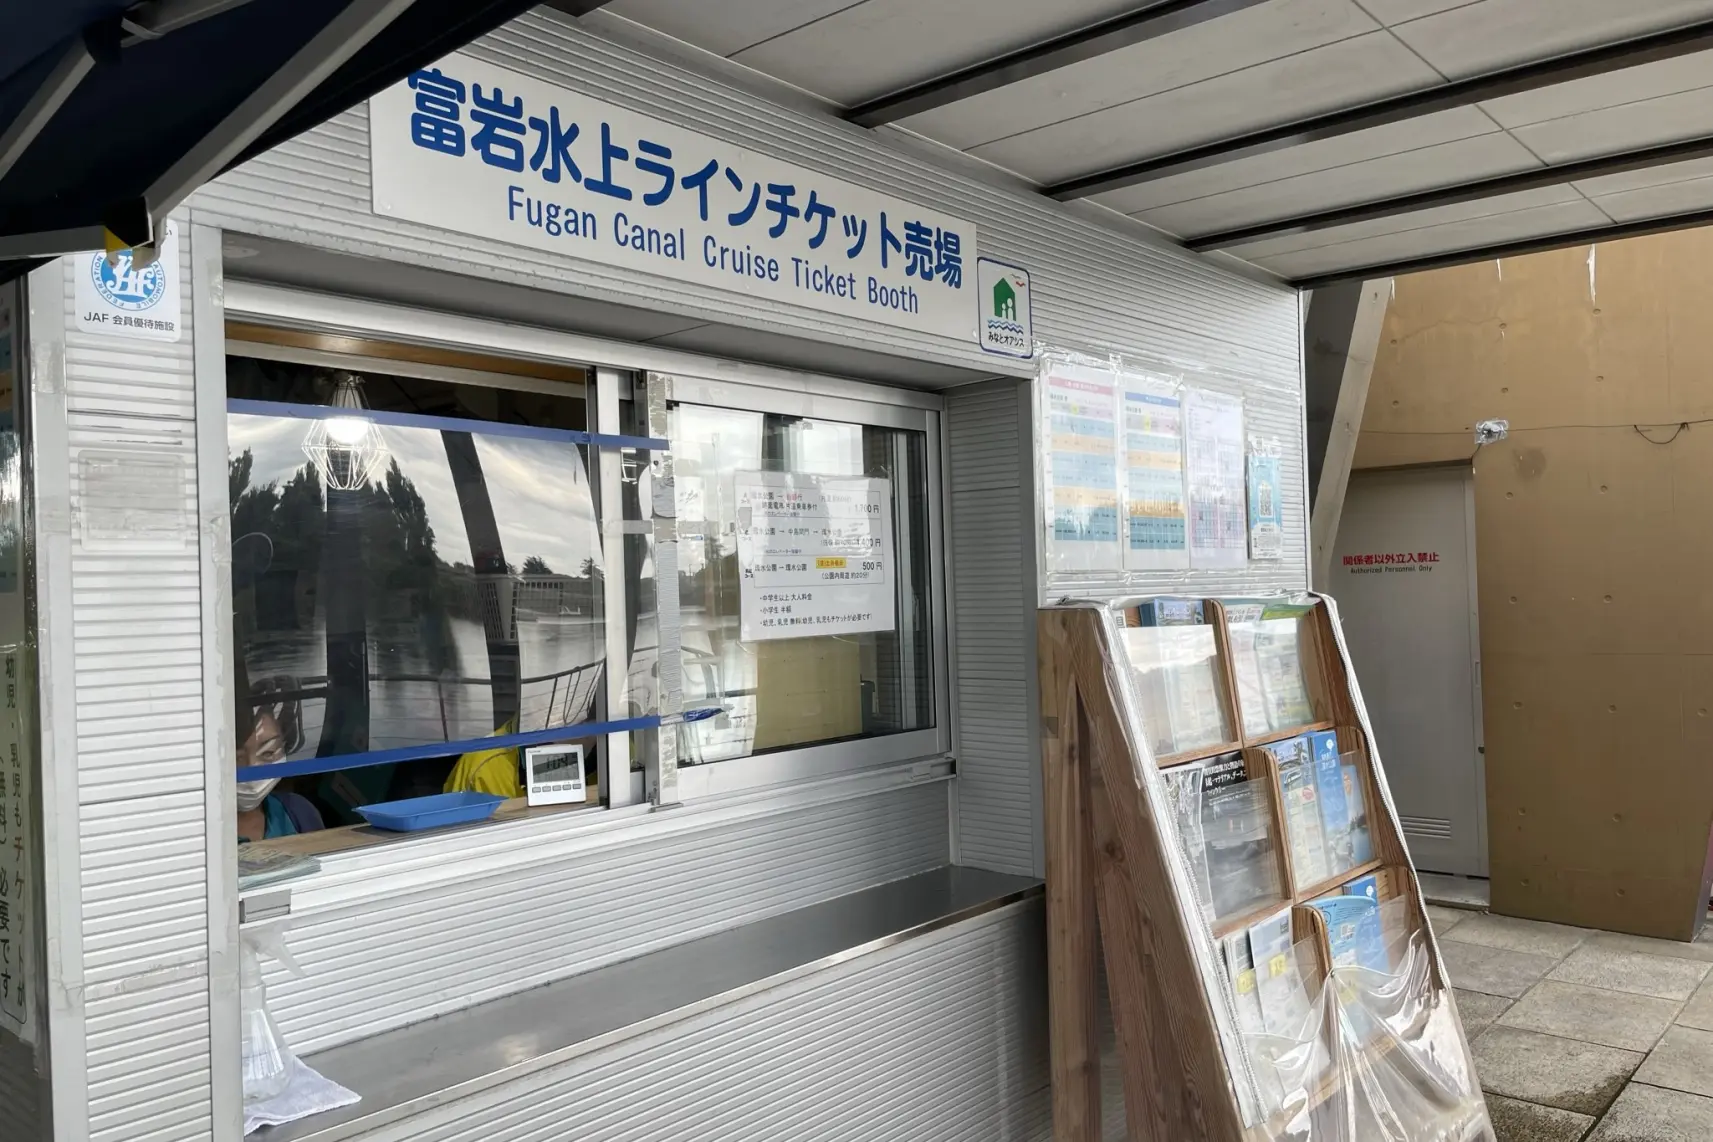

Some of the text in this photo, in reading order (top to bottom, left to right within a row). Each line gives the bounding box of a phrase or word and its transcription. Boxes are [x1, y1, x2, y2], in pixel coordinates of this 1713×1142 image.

[406, 68, 962, 289] 富岩水上ラインチケット売場
[508, 185, 920, 314] Fugan Canal Cruise Ticket Booth
[84, 312, 175, 331] JAF 会員優待施設
[988, 331, 1024, 347] みなとオアシス
[1343, 552, 1440, 566] 関係者以外立入禁止
[1418, 565, 1432, 573] Only
